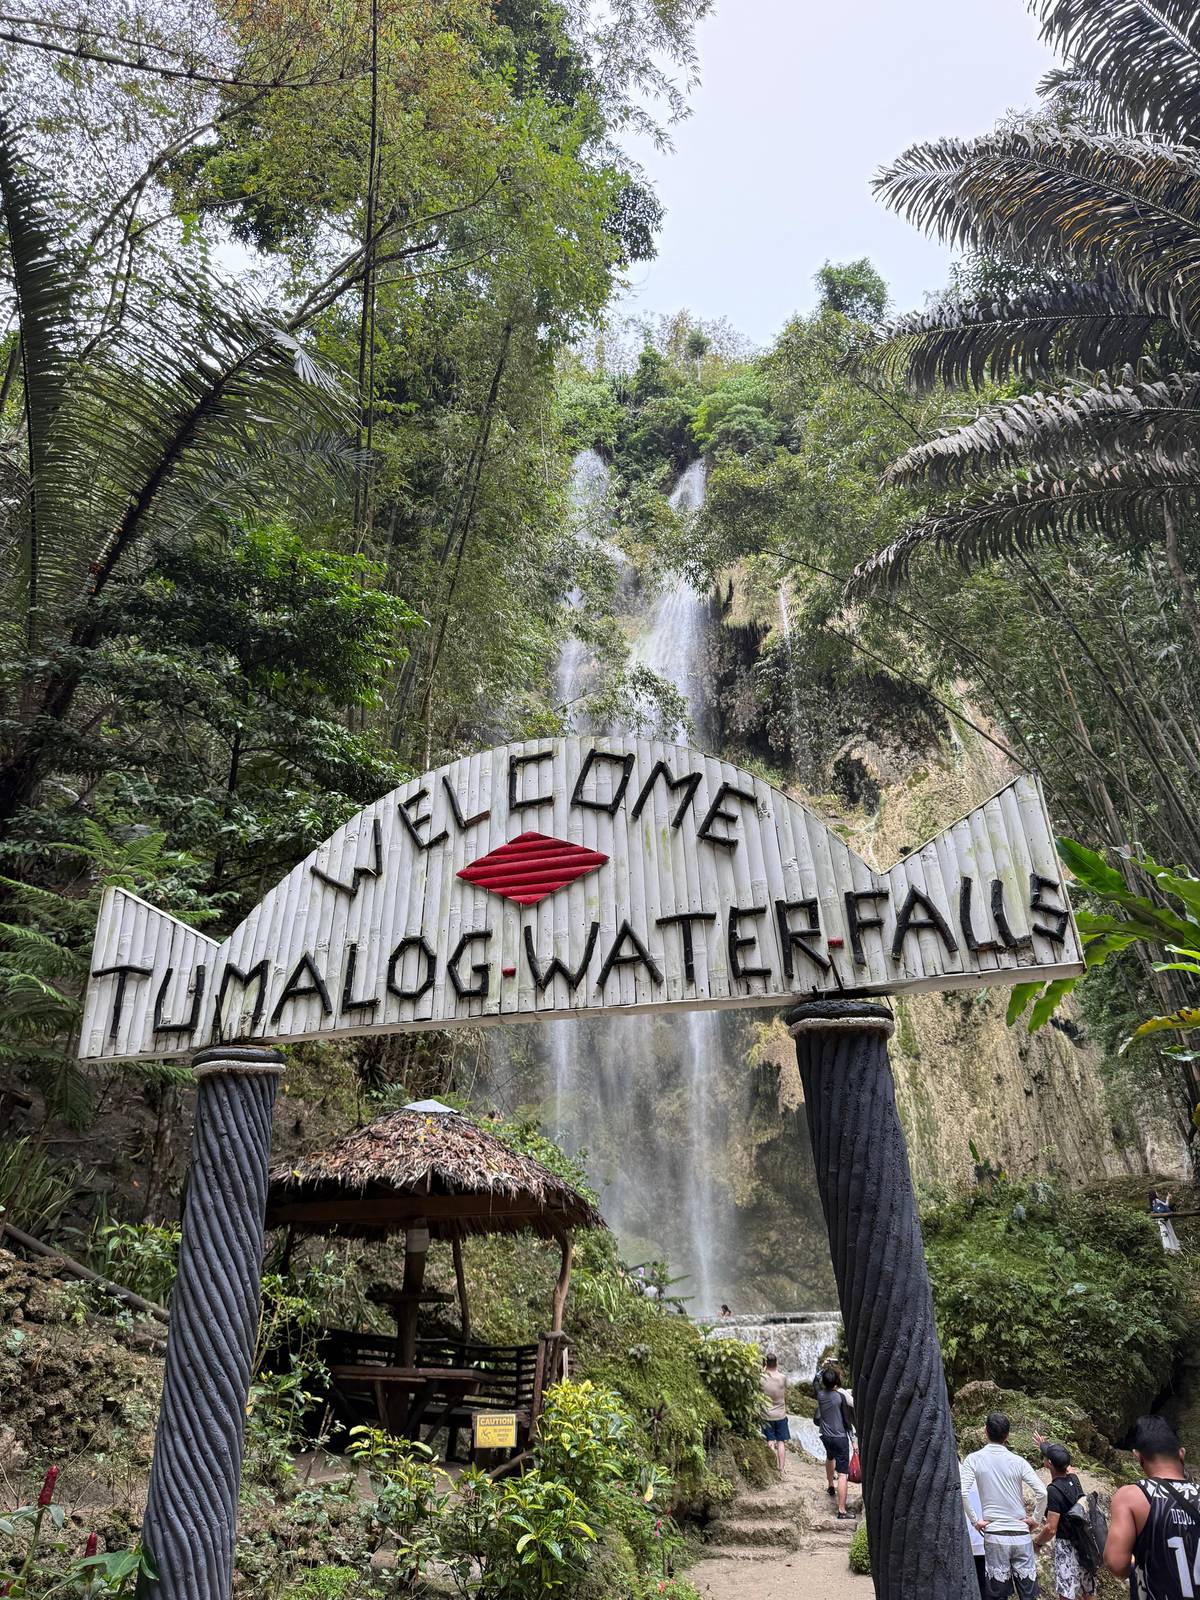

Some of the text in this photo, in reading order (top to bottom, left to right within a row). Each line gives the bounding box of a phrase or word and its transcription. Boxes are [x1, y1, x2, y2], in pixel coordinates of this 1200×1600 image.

[310, 748, 758, 897] WELCOME
[91, 872, 1070, 1043] TUMALOG WATER FALLS
